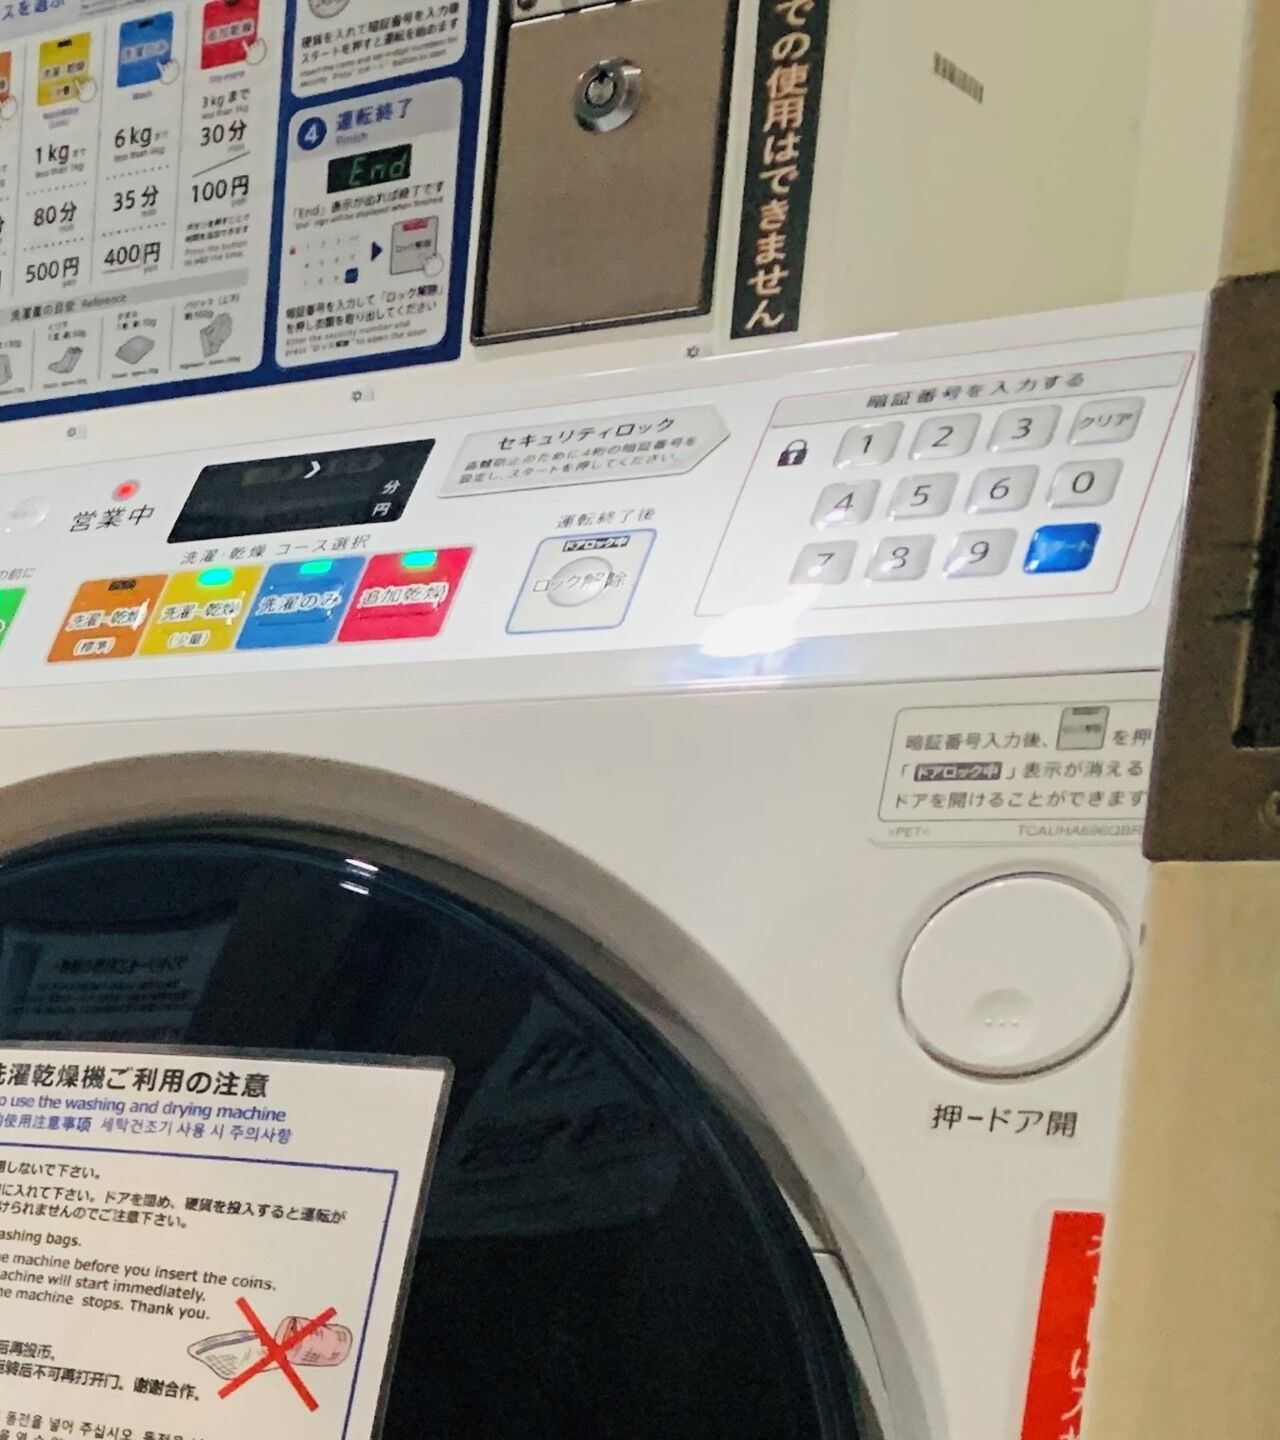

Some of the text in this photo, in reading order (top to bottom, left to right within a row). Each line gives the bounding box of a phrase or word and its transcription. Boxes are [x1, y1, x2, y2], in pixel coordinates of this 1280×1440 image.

[335, 99, 413, 132] 運転終了
[305, 125, 319, 142] 4
[348, 149, 408, 188] End
[866, 372, 1086, 408] 暗証番号を入力する
[499, 418, 674, 450] セキュリティロック
[862, 434, 874, 453] 1
[932, 426, 954, 448] 2
[1012, 417, 1031, 440] 3
[382, 478, 402, 496] 分
[834, 470, 1094, 511] 4 5 6 0
[69, 503, 156, 533] 営業中
[372, 502, 392, 518] 円
[891, 546, 910, 569] 8
[970, 540, 990, 563] 9
[258, 594, 341, 614] 洗濯のみ
[10, 1096, 35, 1108] use
[38, 1095, 62, 1110] the
[65, 1097, 127, 1116] washing
[129, 1100, 160, 1114] and
[162, 1101, 213, 1121] drying
[215, 1105, 287, 1123] machine
[176, 1122, 205, 1139] 사용
[210, 1123, 225, 1140] 시
[45, 1231, 82, 1249] bags.
[12, 1254, 71, 1270] machine
[73, 1258, 120, 1274] before
[124, 1265, 151, 1278] you
[154, 1265, 199, 1283] insert
[202, 1271, 228, 1286] the
[231, 1276, 276, 1291] coins.
[47, 1274, 72, 1287] will
[74, 1277, 110, 1291] start
[112, 1279, 206, 1304] immediately.
